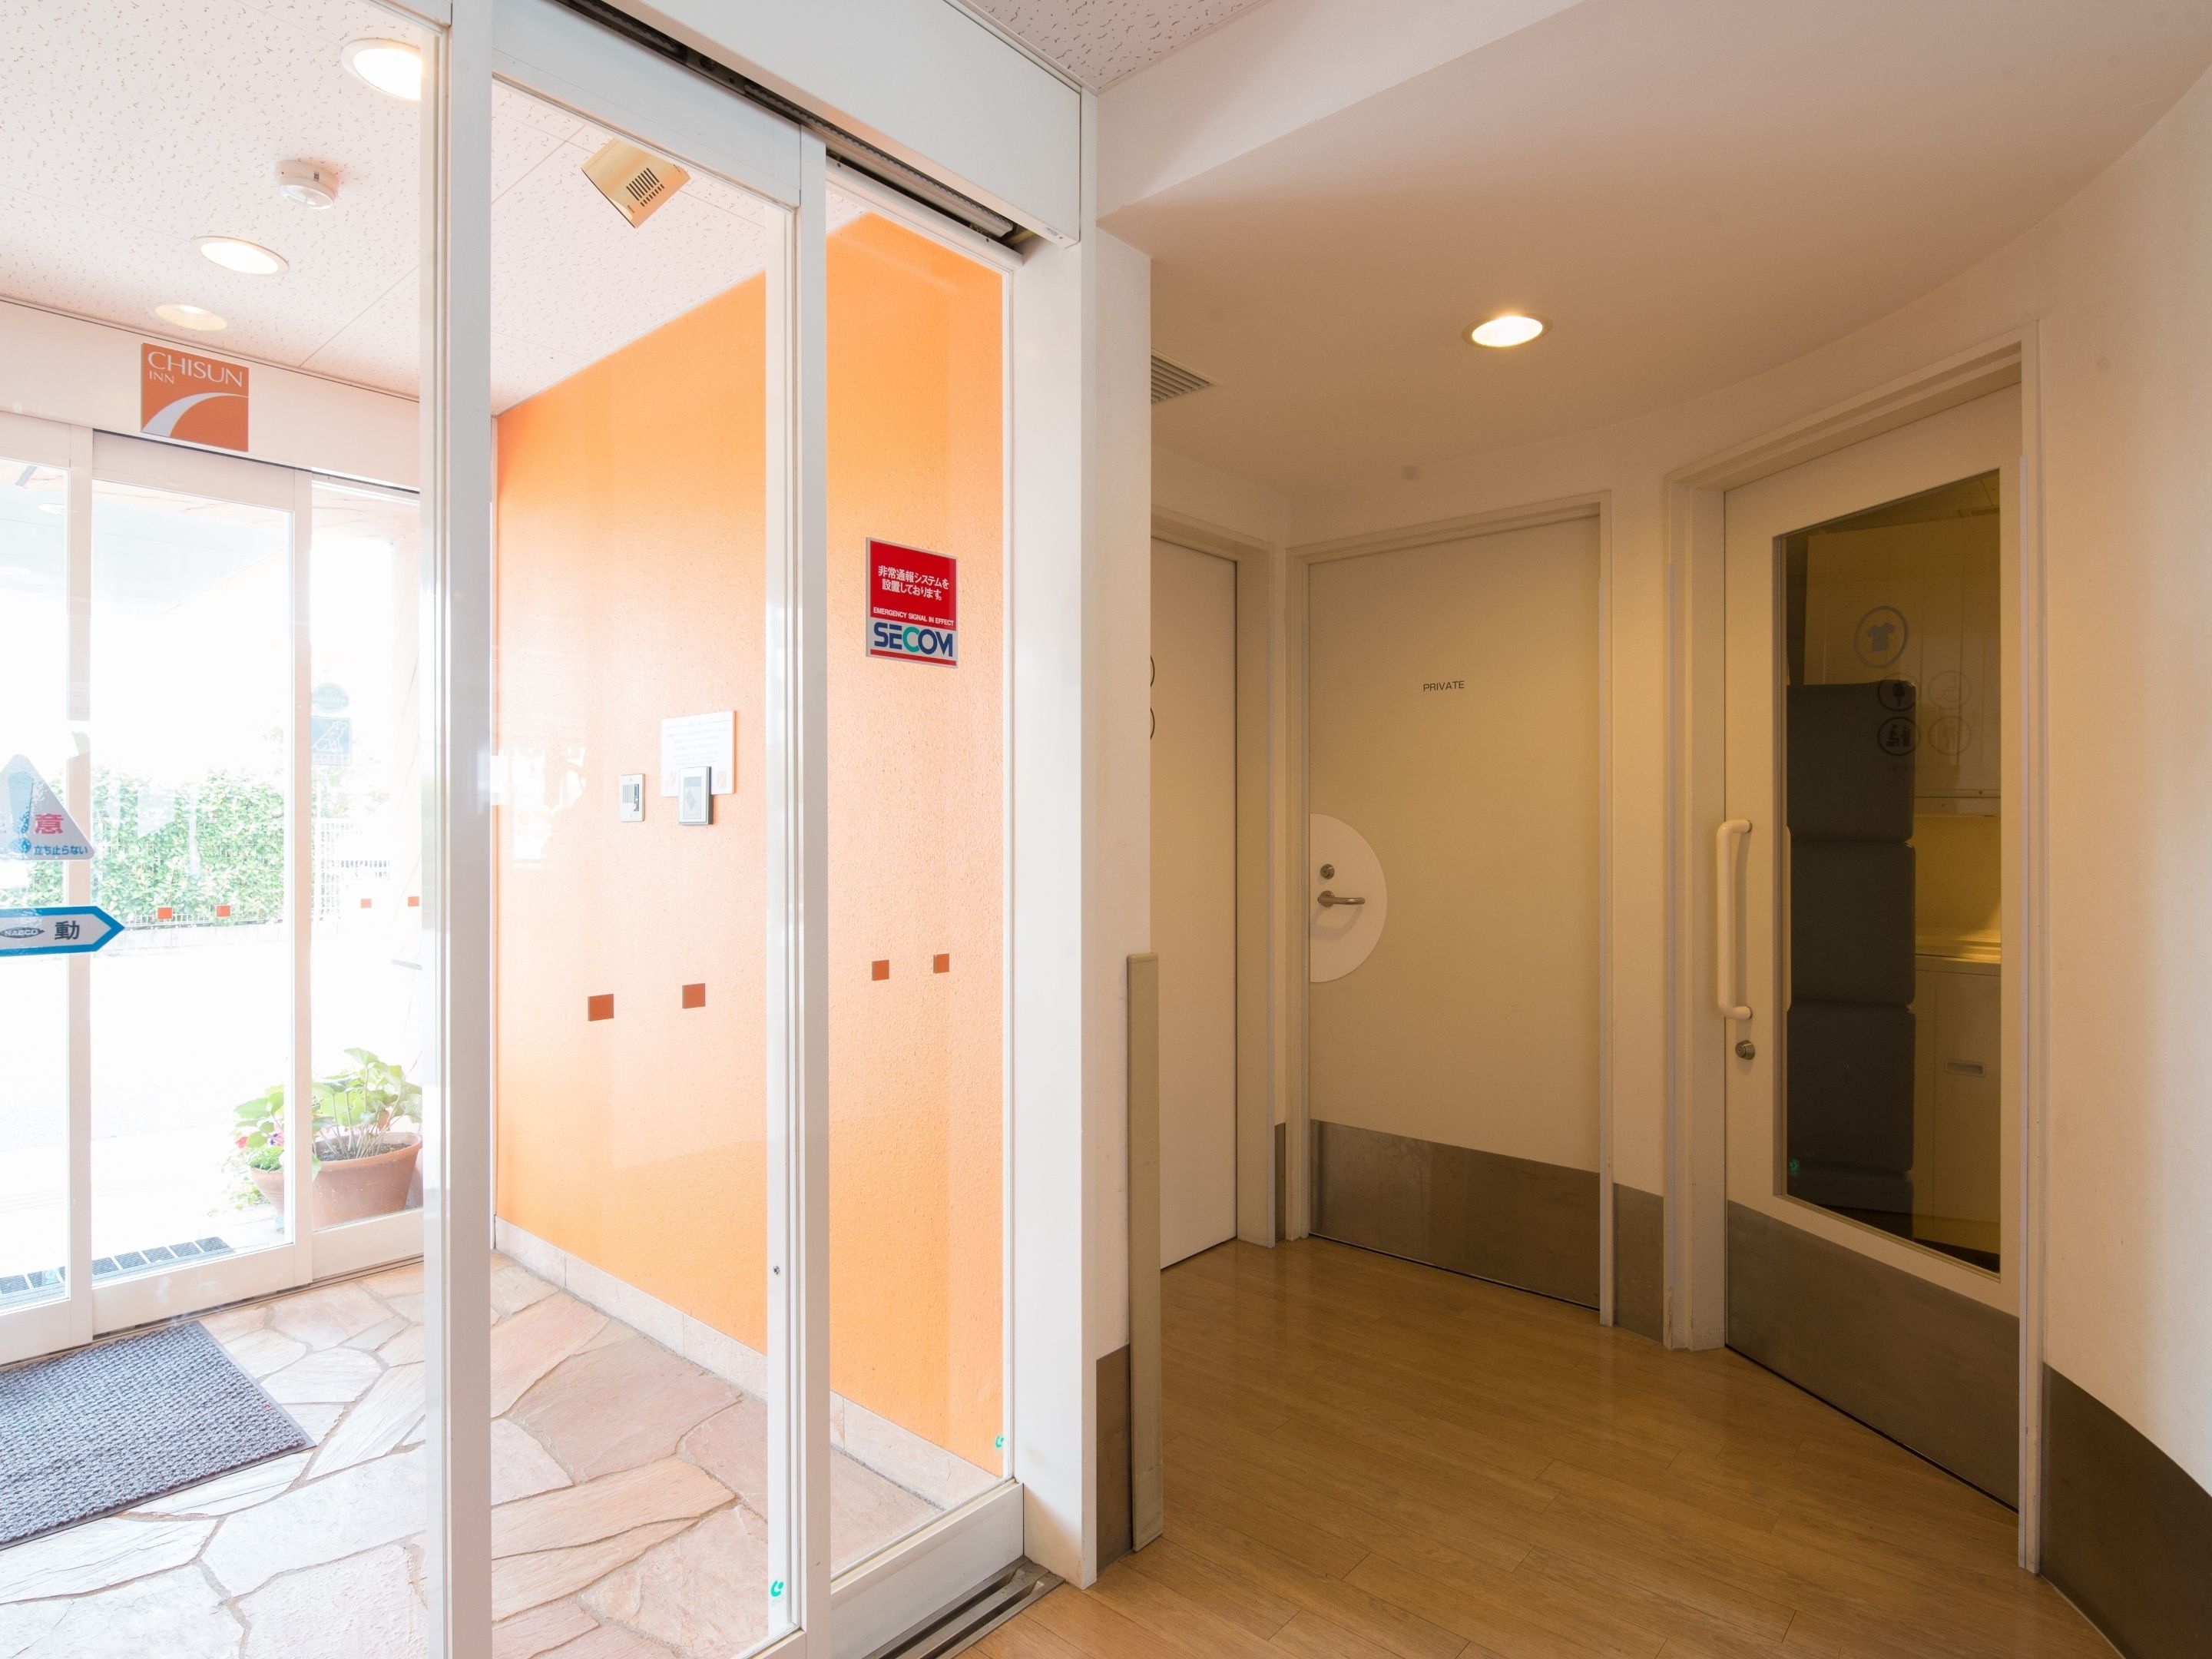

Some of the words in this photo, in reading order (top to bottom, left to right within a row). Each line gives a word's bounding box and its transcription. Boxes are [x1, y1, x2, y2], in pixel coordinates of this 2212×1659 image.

[147, 351, 243, 388] CHISUN
[149, 370, 174, 384] INN
[878, 565, 949, 590] 非常通報システムを
[882, 578, 942, 601] 設置しております。
[873, 607, 907, 619] EMERGENCY
[908, 613, 928, 623] SIGNAL
[935, 618, 954, 627] EFFECT
[873, 621, 953, 657] SECOM
[1423, 680, 1465, 692] PRIVATE
[34, 845, 88, 856] 立ち止らない
[55, 921, 80, 940] 動
